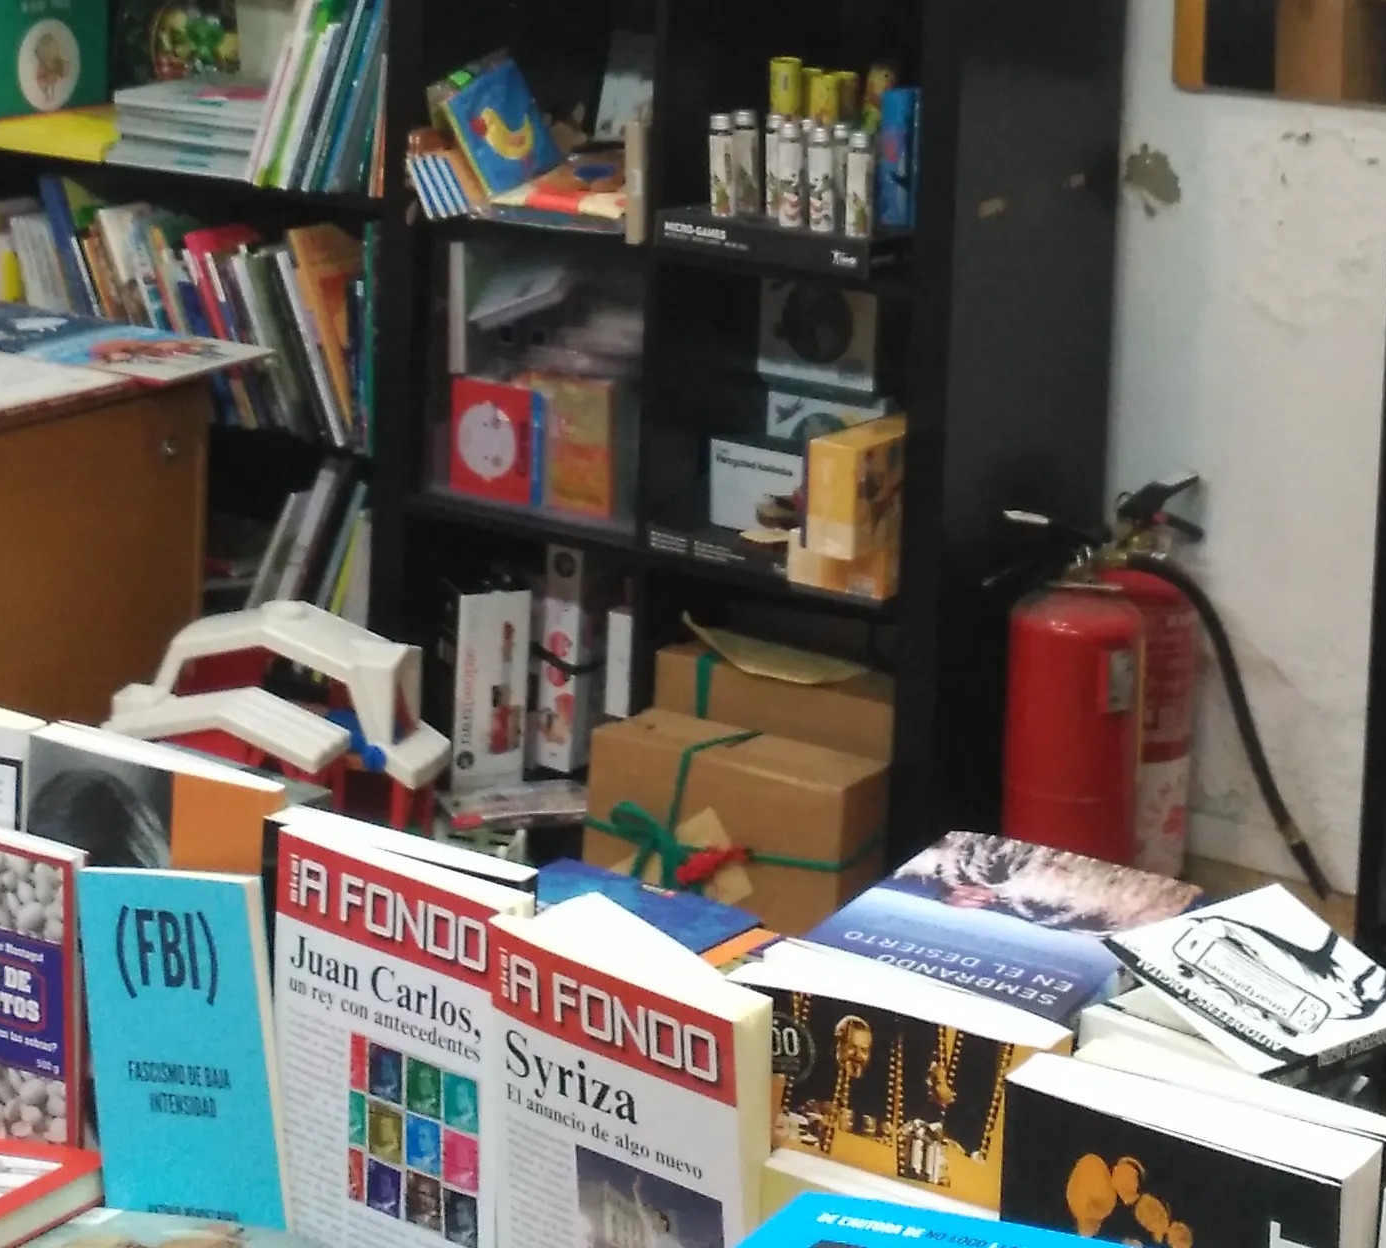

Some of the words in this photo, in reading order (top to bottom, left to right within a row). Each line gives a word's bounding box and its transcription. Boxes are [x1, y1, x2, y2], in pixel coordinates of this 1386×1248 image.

[299, 858, 329, 915] A
[340, 871, 488, 973] FONDO
[4, 964, 32, 994] DE
[116, 905, 219, 1007] (FBI)
[844, 930, 980, 968] DESIERTO
[992, 962, 1025, 979] EL
[291, 935, 359, 991] Juan
[371, 965, 482, 1043] Carlos,
[1031, 974, 1074, 993] EN
[289, 977, 307, 996] un
[312, 984, 334, 1010] rey
[341, 998, 369, 1020] con
[374, 1009, 482, 1063] antecedentes
[510, 953, 540, 1013] A
[552, 972, 719, 1082] FONDO
[128, 1060, 185, 1087] FASCISMO
[187, 1065, 203, 1088] DE
[204, 1066, 232, 1090] BAJA
[150, 1092, 218, 1119] INTENSIDAD
[506, 1029, 638, 1125] Syriza
[507, 1083, 522, 1105] El
[527, 1097, 587, 1133] anuncio
[591, 1121, 610, 1142] de
[615, 1133, 651, 1158] algo
[656, 1151, 704, 1180] nuevo
[816, 1211, 840, 1224] DE
[902, 1225, 927, 1238] DE
